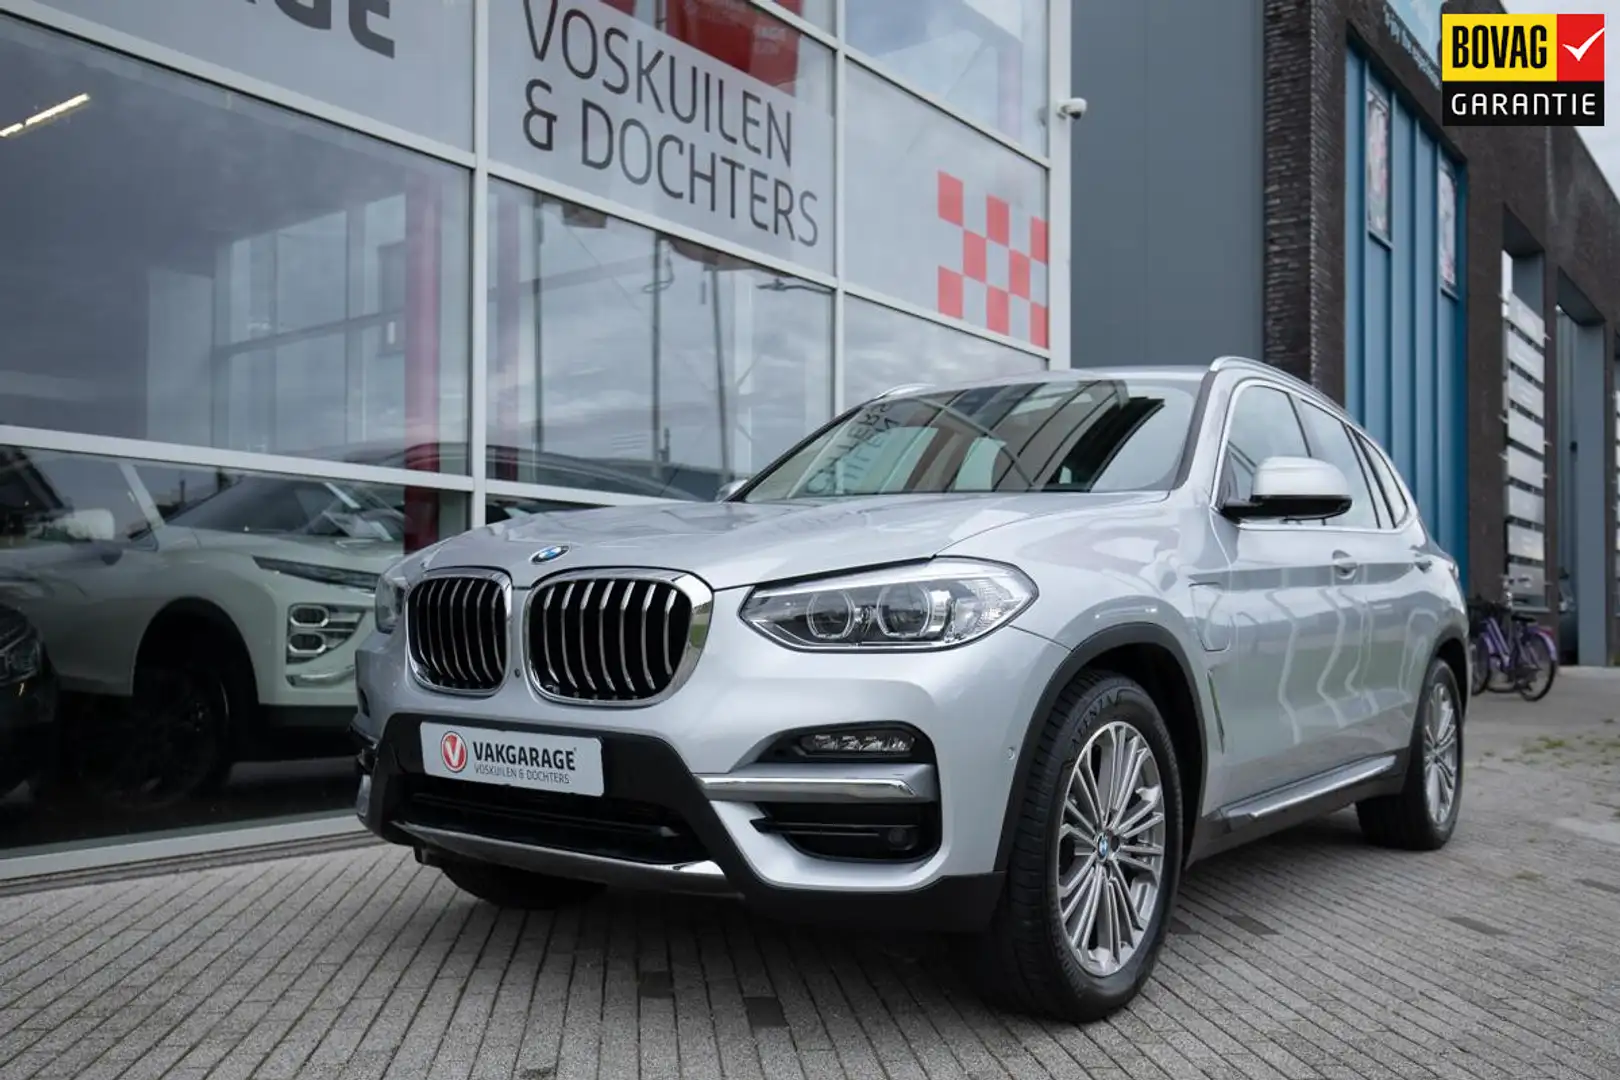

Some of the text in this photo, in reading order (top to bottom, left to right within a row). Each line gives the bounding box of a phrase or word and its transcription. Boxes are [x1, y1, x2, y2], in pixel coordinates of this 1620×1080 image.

[523, 0, 791, 167] VOSKUILEN
[523, 79, 818, 247] & DOCHTERS
[473, 741, 576, 771] VAKGARAGE
[474, 764, 517, 778] VOSKUILEN
[527, 770, 570, 784] DOCHTERS
